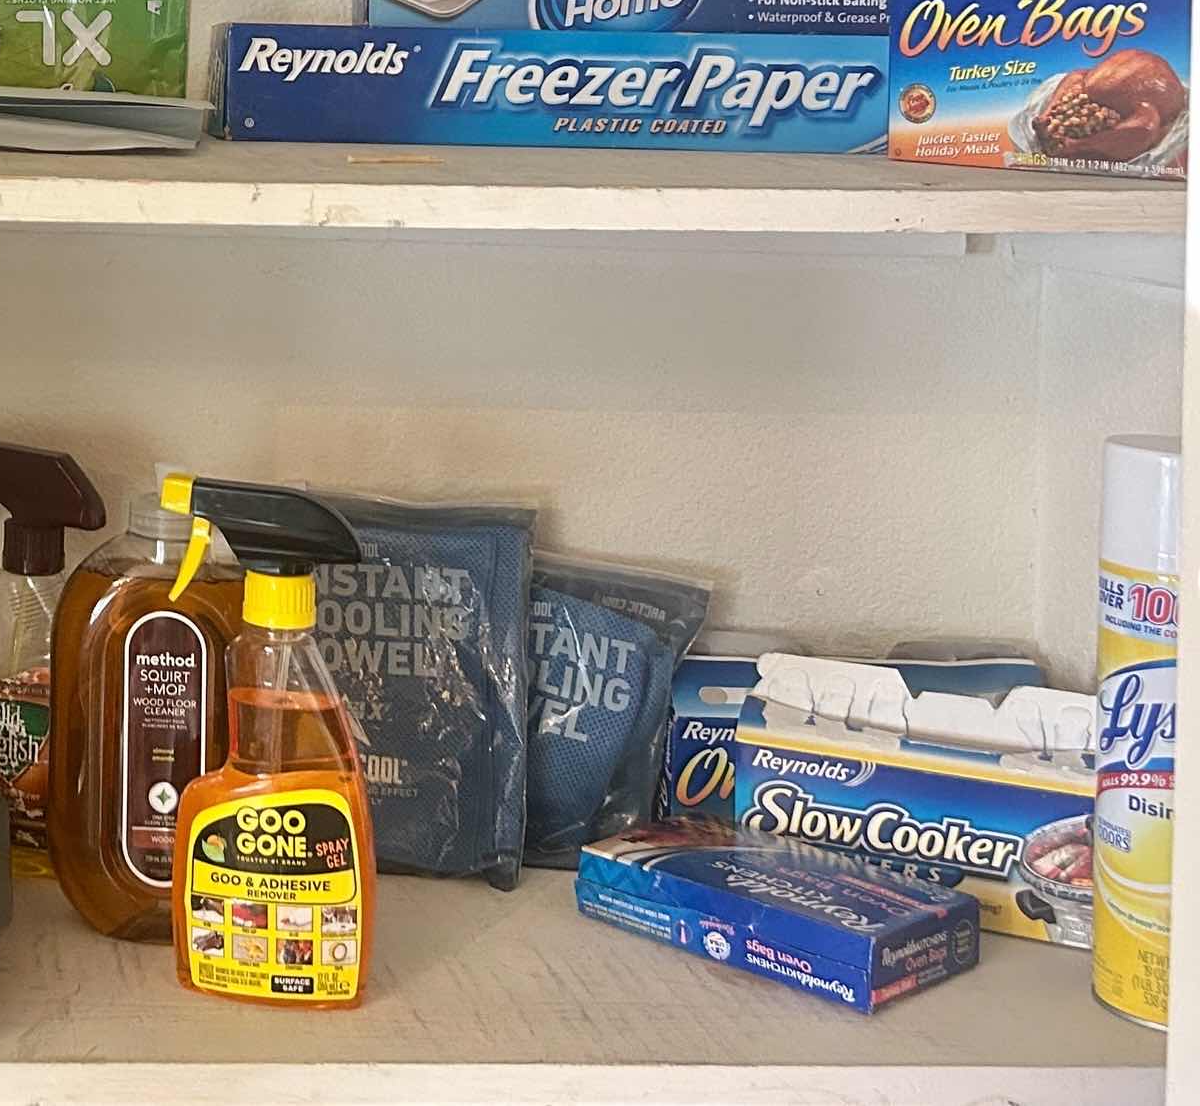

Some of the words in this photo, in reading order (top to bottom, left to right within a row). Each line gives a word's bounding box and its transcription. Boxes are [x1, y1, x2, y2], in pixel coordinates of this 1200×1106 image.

[757, 11, 823, 25] Waterproof
[824, 12, 835, 24] &
[837, 12, 876, 25] Grease
[15, 10, 112, 67] XL
[238, 37, 410, 82] Reynolds
[949, 64, 1001, 82] Turkey
[1003, 60, 1037, 77] Size
[440, 49, 684, 108] Freezer
[681, 54, 875, 128] Paper
[553, 117, 641, 133] PLASTIC
[650, 118, 727, 135] COATED
[959, 132, 1001, 144] Tastier
[915, 144, 961, 158] Holiday
[963, 143, 1001, 155] Meals
[315, 563, 469, 601] NSTANT
[318, 599, 470, 640] OOLING
[1144, 625, 1162, 636] THE
[318, 638, 440, 676] OWEL
[530, 622, 636, 674] TANT
[136, 652, 196, 668] method
[140, 669, 191, 684] SQUIRT
[537, 660, 631, 713] LING
[144, 684, 186, 696] +MOP
[133, 697, 163, 708] WOOD
[165, 698, 197, 709] FLOOR
[144, 707, 185, 717] CLEANER
[1100, 674, 1176, 767] Lys
[682, 721, 735, 744] Reyn
[752, 748, 851, 783] Reynolds
[1120, 773, 1166, 787] 99.9%
[236, 806, 306, 834] GOO
[748, 787, 862, 844] Slow
[866, 811, 1019, 870] Cooker
[236, 832, 307, 859] GONE
[315, 838, 349, 857] SPRAY
[237, 855, 268, 864] TRUSTED
[282, 858, 307, 867] BRAND
[326, 854, 347, 870] GEL
[210, 872, 241, 885] GOO
[245, 876, 254, 887] &
[259, 878, 331, 892] ADHESIVE
[247, 889, 297, 901] REMOVER
[722, 872, 886, 933] Reynolds
[746, 939, 774, 961] Bags
[777, 951, 811, 974] Oven
[274, 977, 310, 986] SURFACE
[282, 984, 304, 993] SAFE
